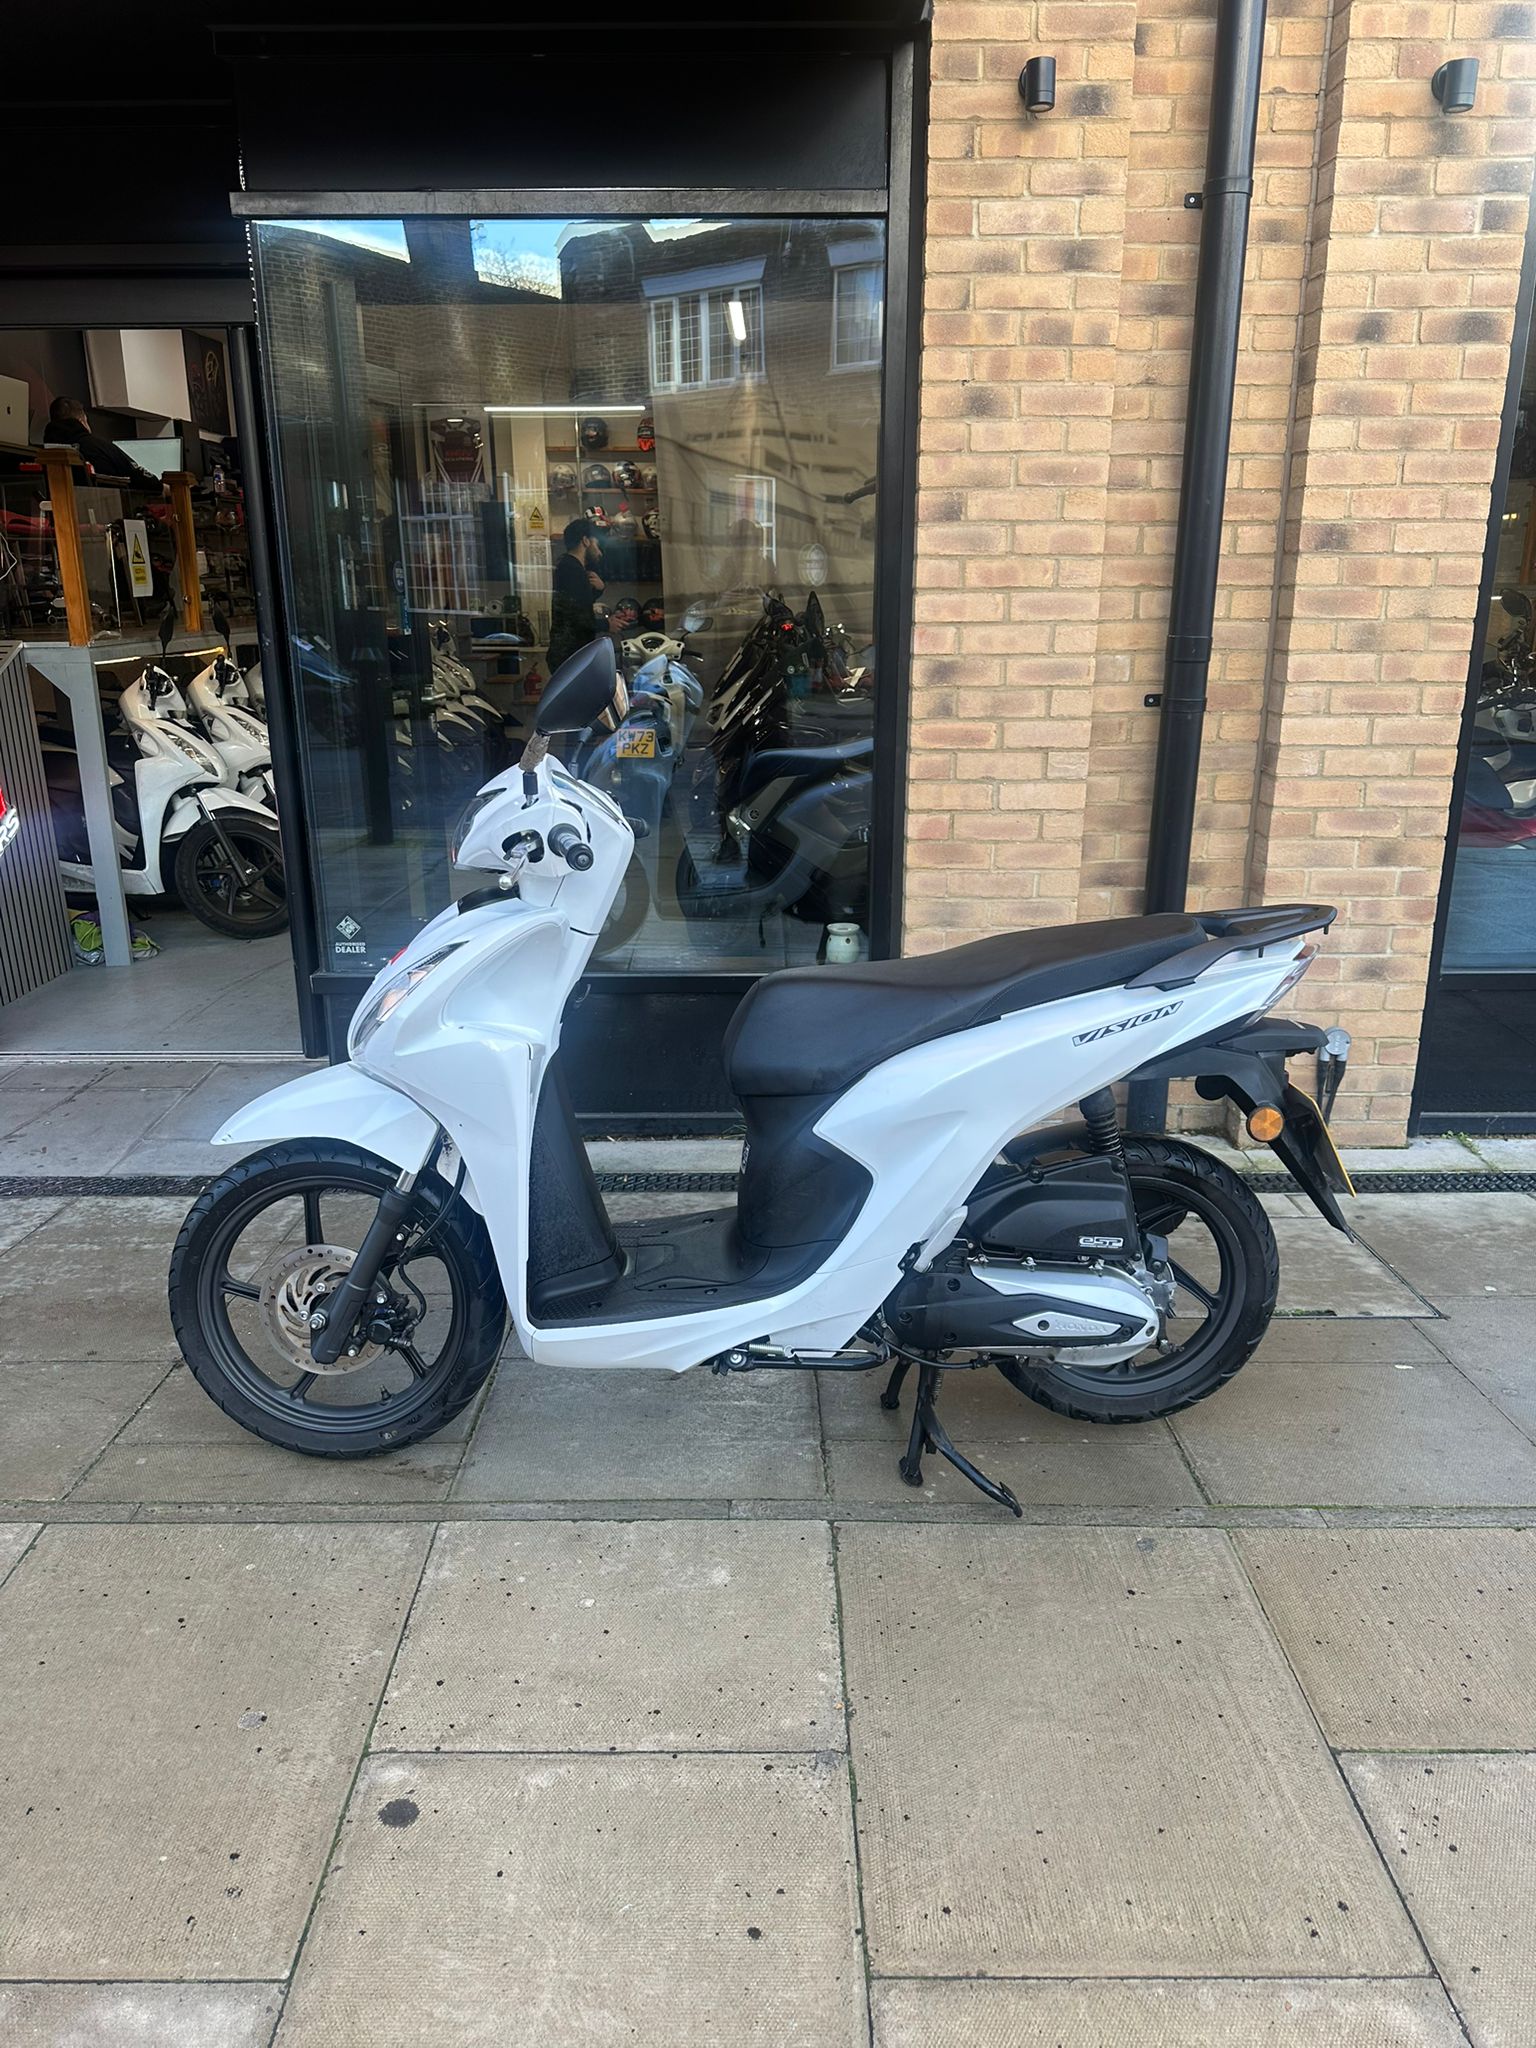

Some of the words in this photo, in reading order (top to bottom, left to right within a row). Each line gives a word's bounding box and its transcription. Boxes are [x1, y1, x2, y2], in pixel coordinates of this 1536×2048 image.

[618, 731, 655, 742] KW73
[623, 743, 650, 754] PKZ
[1072, 1000, 1184, 1047] VISION
